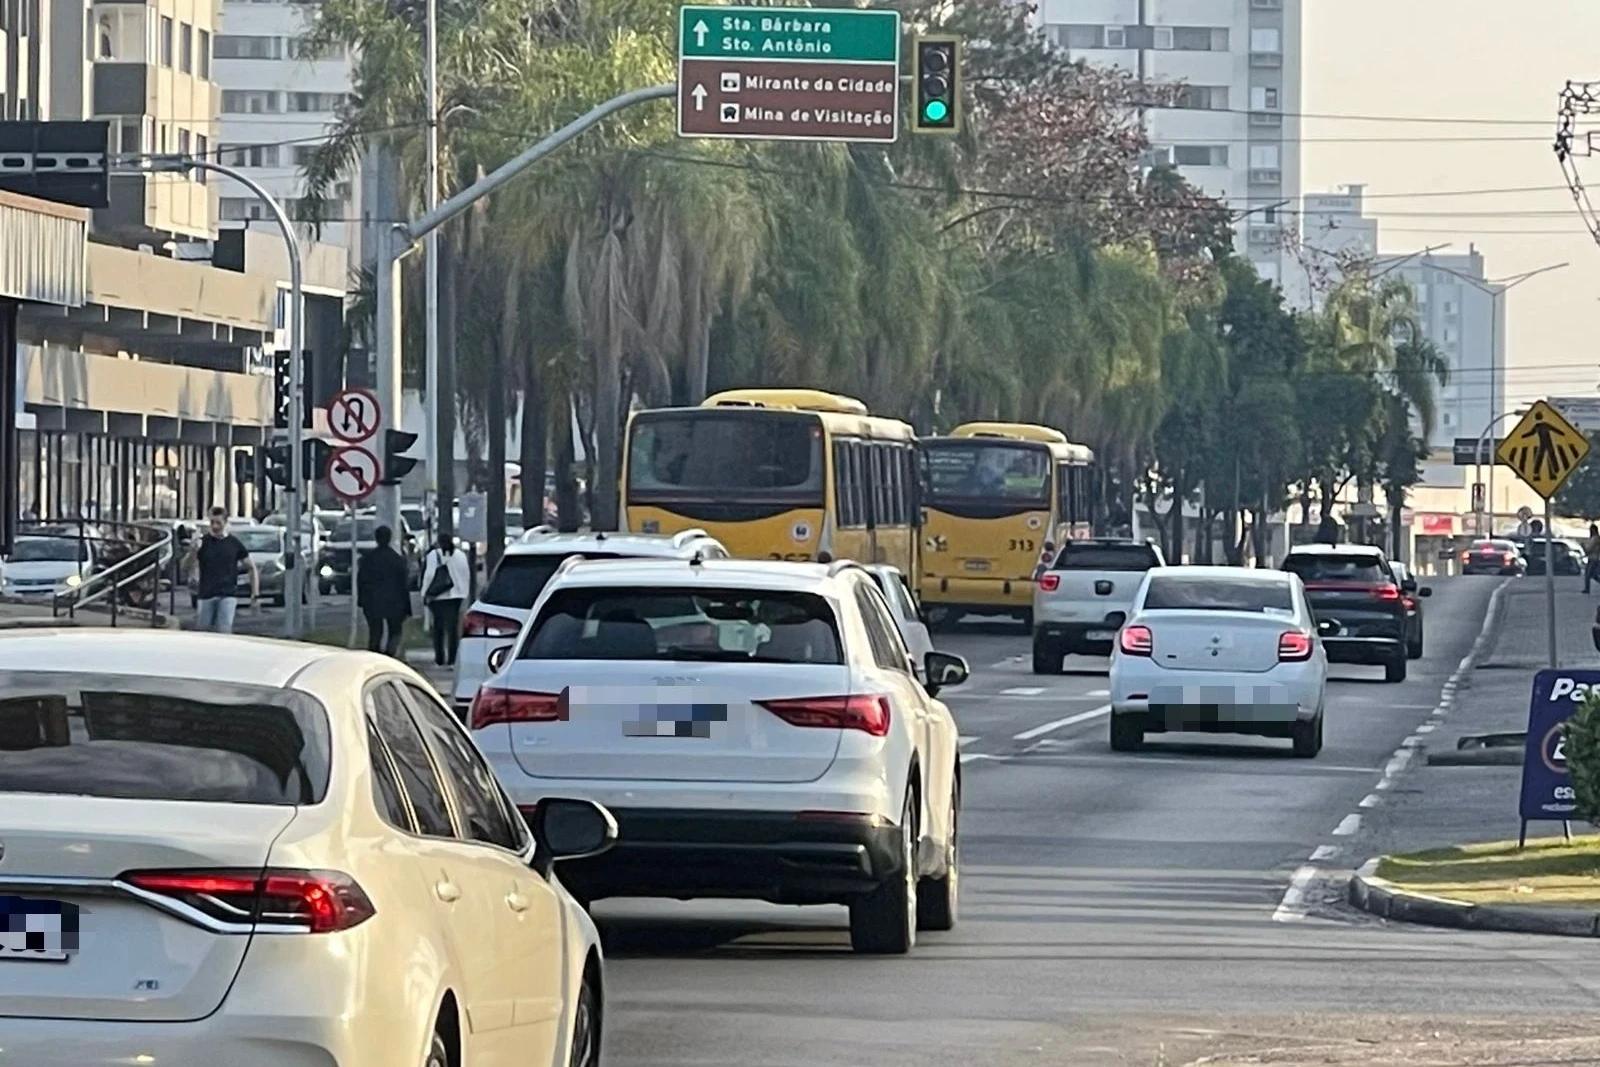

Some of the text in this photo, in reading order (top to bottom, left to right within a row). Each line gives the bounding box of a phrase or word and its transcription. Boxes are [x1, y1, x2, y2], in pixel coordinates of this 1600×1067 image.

[722, 17, 831, 33] Sta. Bárbara
[722, 37, 832, 53] Sto. Antônio
[745, 76, 893, 93] Mirante da Cidade
[744, 107, 893, 127] Mina de Visitação
[1009, 538, 1034, 552] 313
